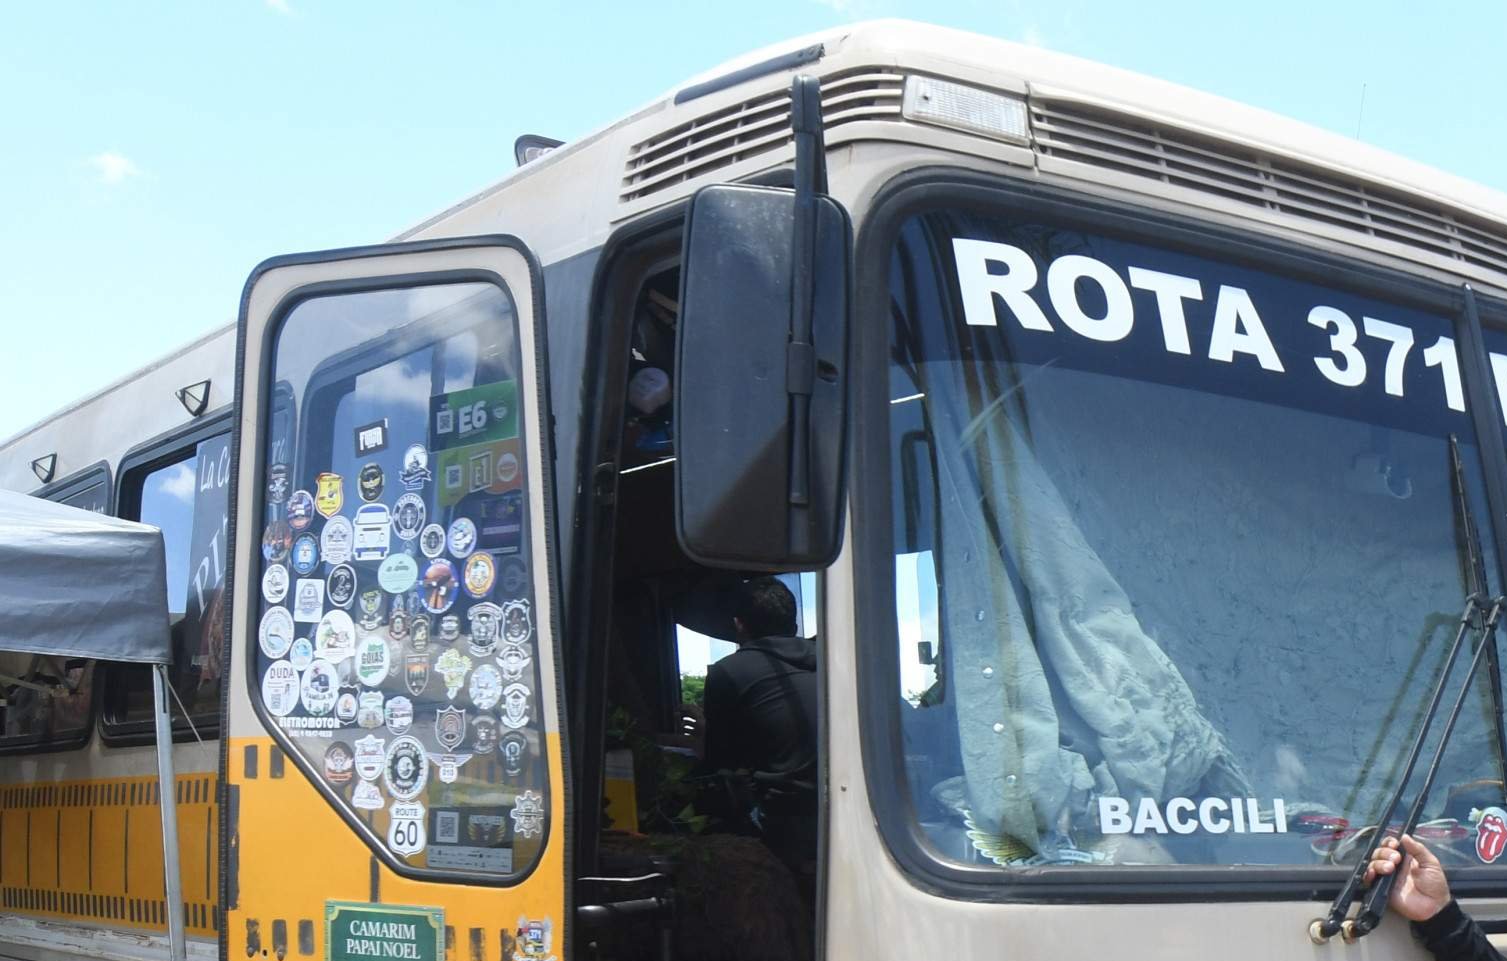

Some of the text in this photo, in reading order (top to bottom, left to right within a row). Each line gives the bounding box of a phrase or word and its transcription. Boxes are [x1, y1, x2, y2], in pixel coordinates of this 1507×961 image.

[951, 238, 1285, 373] ROTA
[1306, 305, 1466, 413] 371
[458, 400, 487, 434] E6
[270, 667, 294, 679] DUDA
[395, 807, 418, 817] ROUTE
[1099, 797, 1288, 835] BACCILI
[394, 821, 417, 846] 60
[349, 919, 416, 940] CAMARIM
[346, 938, 421, 960] PAPAI NOEL
